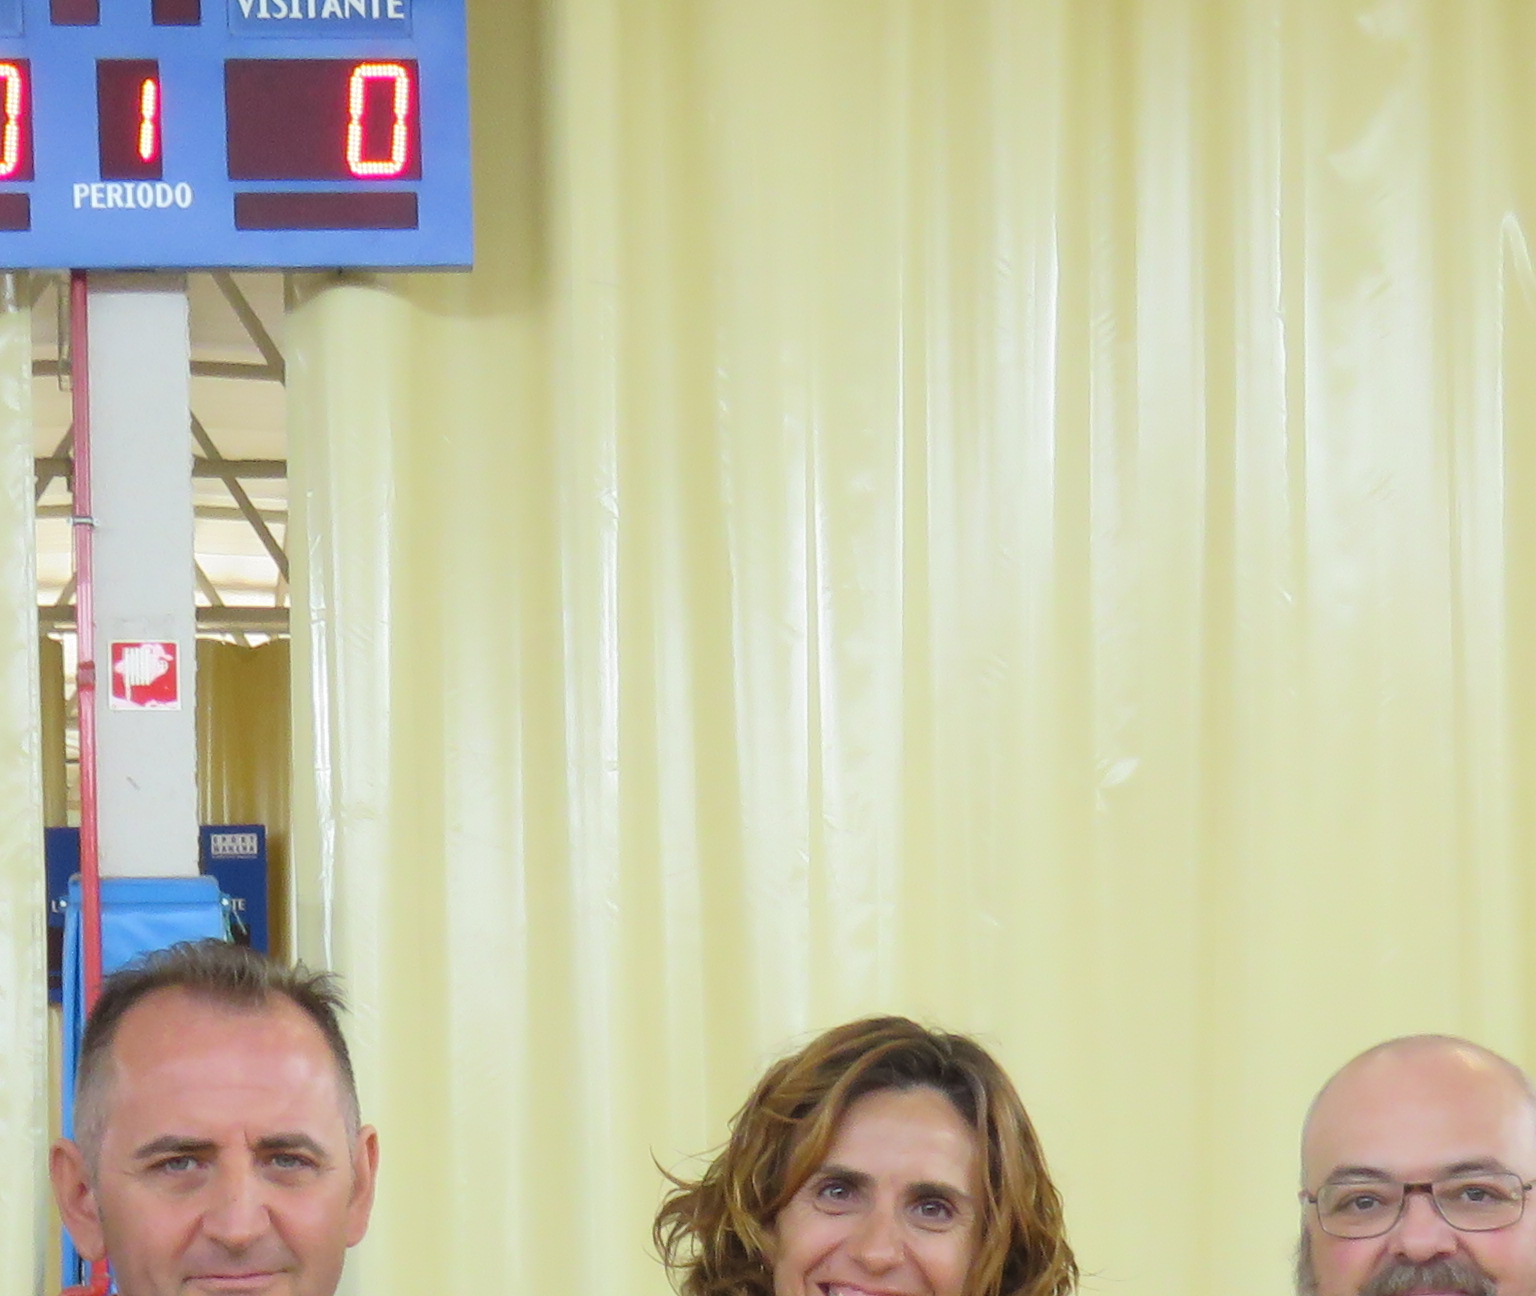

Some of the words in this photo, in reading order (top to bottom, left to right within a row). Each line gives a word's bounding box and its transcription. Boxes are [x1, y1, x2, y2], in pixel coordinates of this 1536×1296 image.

[237, 0, 406, 20] VISITANTE
[137, 78, 156, 160] 1
[346, 62, 409, 177] 0
[72, 182, 192, 210] PERIODO
